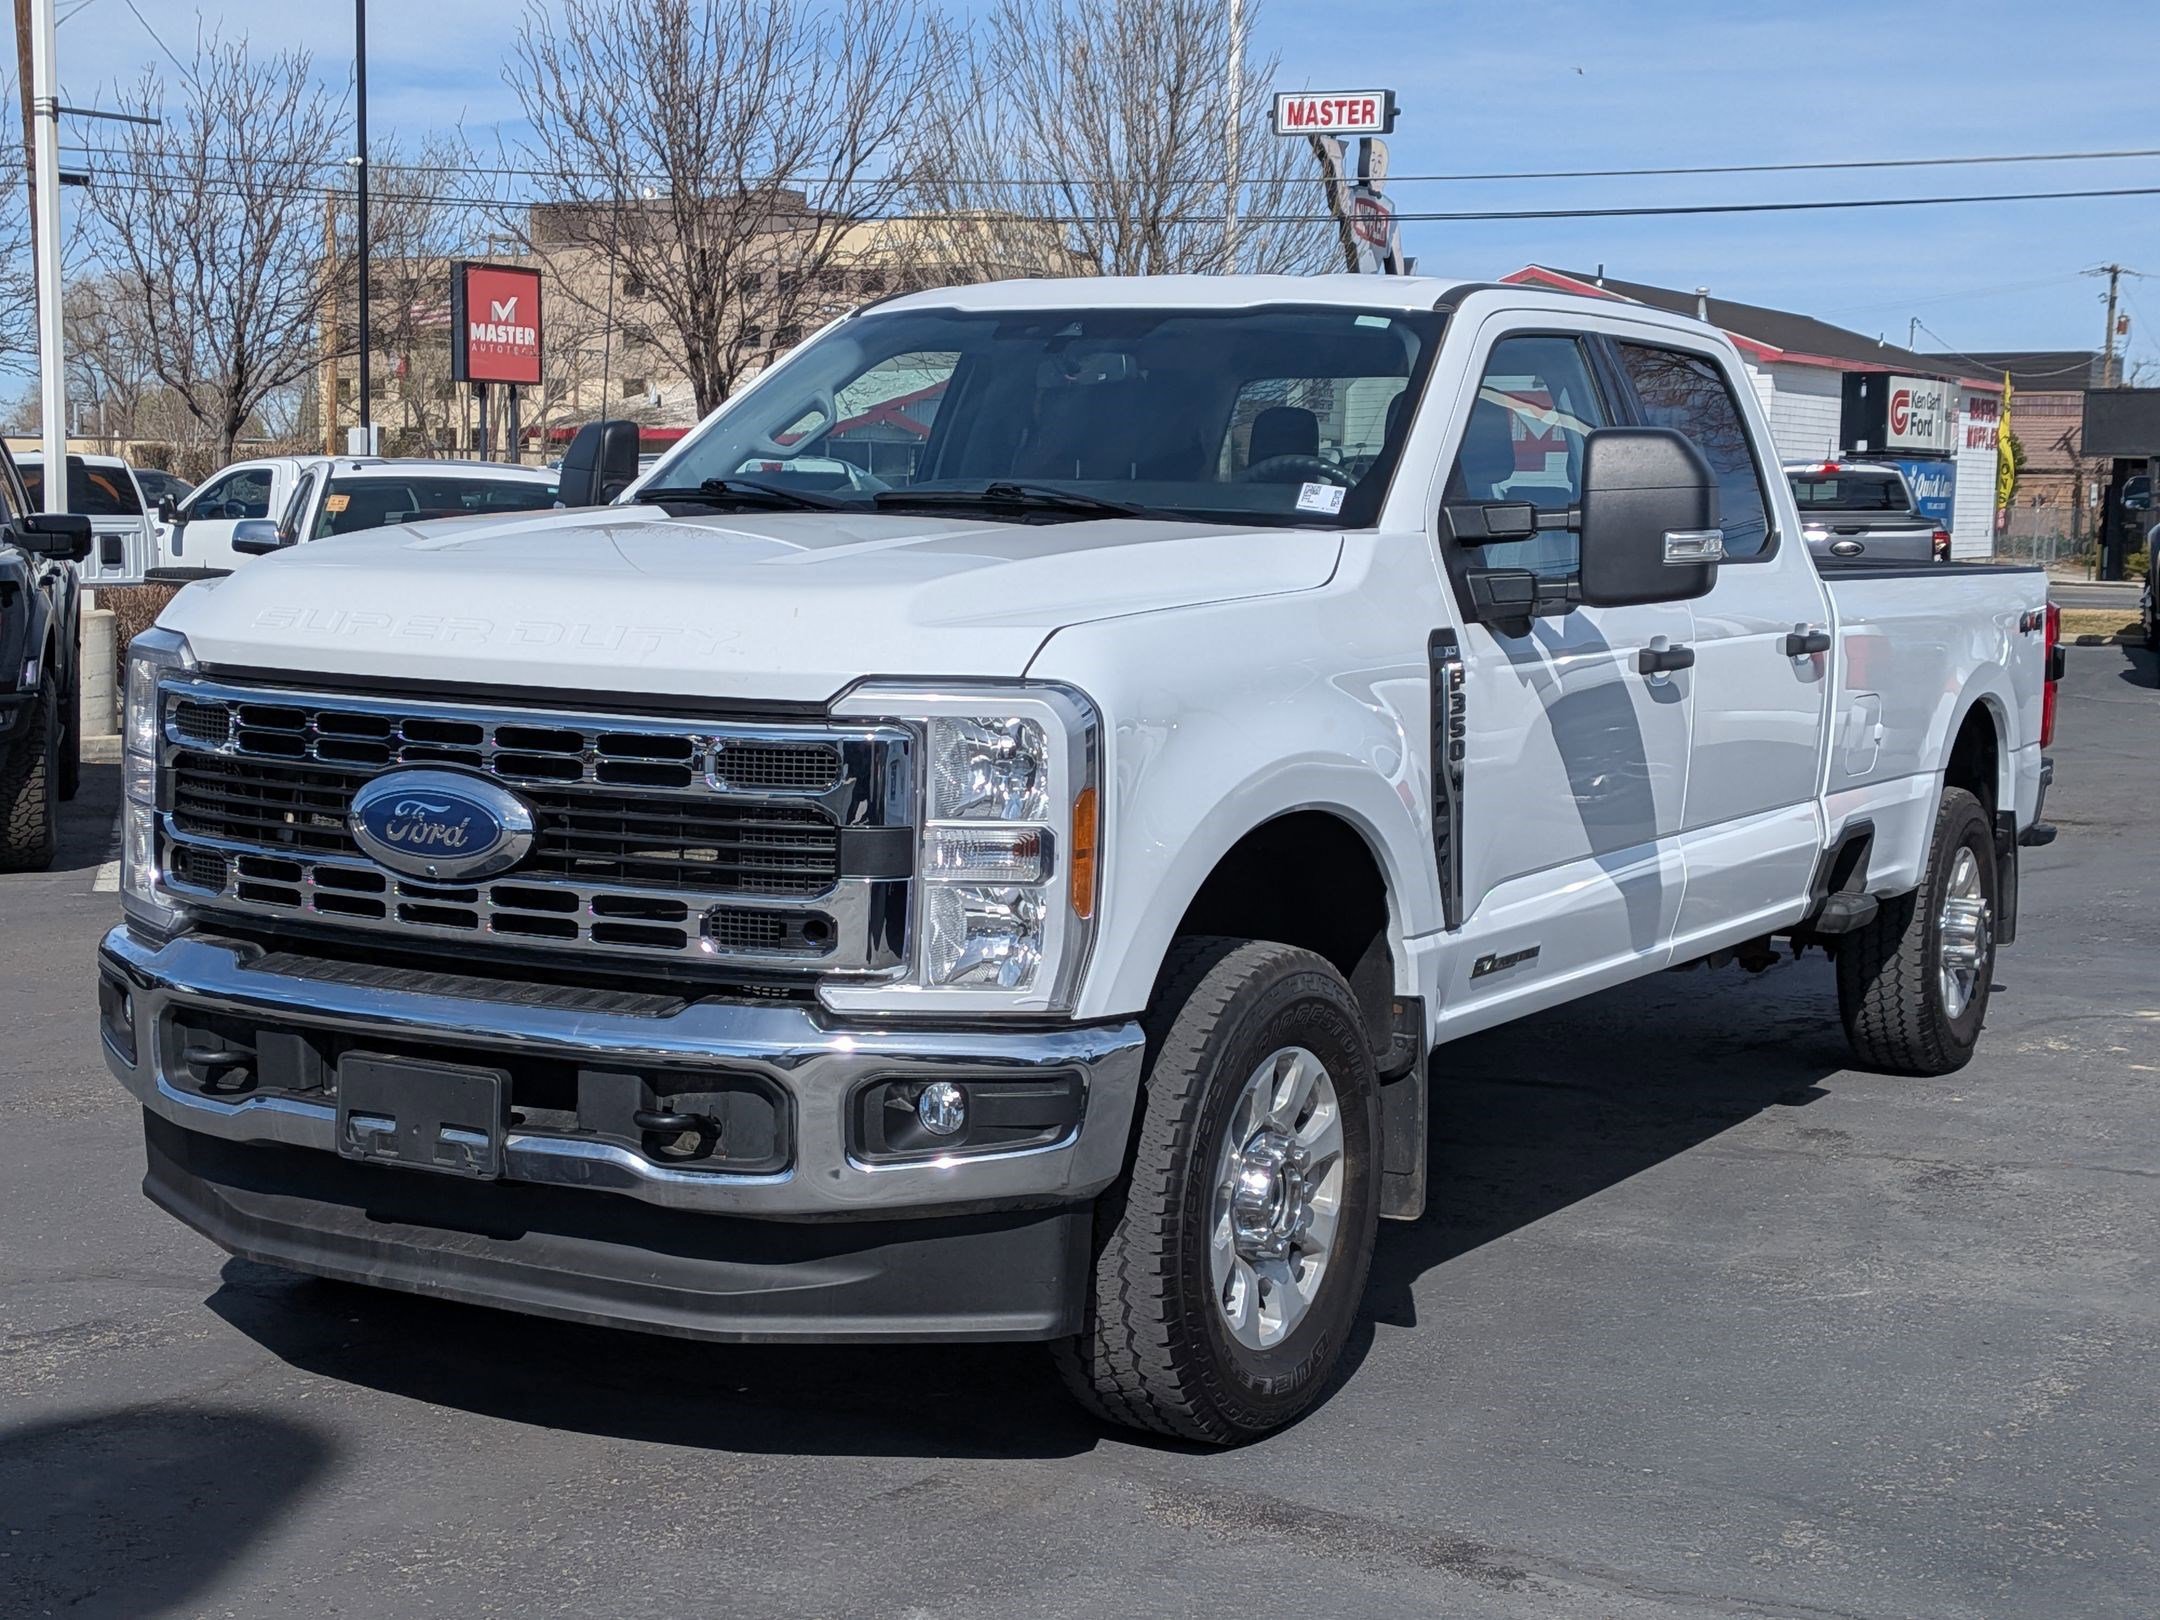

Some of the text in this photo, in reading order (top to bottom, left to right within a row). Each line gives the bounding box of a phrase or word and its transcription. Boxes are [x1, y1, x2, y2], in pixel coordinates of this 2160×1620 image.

[1287, 99, 1375, 126] MASTER
[470, 322, 535, 345] MASTER
[1910, 412, 1934, 437] Ford
[250, 605, 747, 660] SUPER DUTY
[385, 799, 474, 848] Ford
